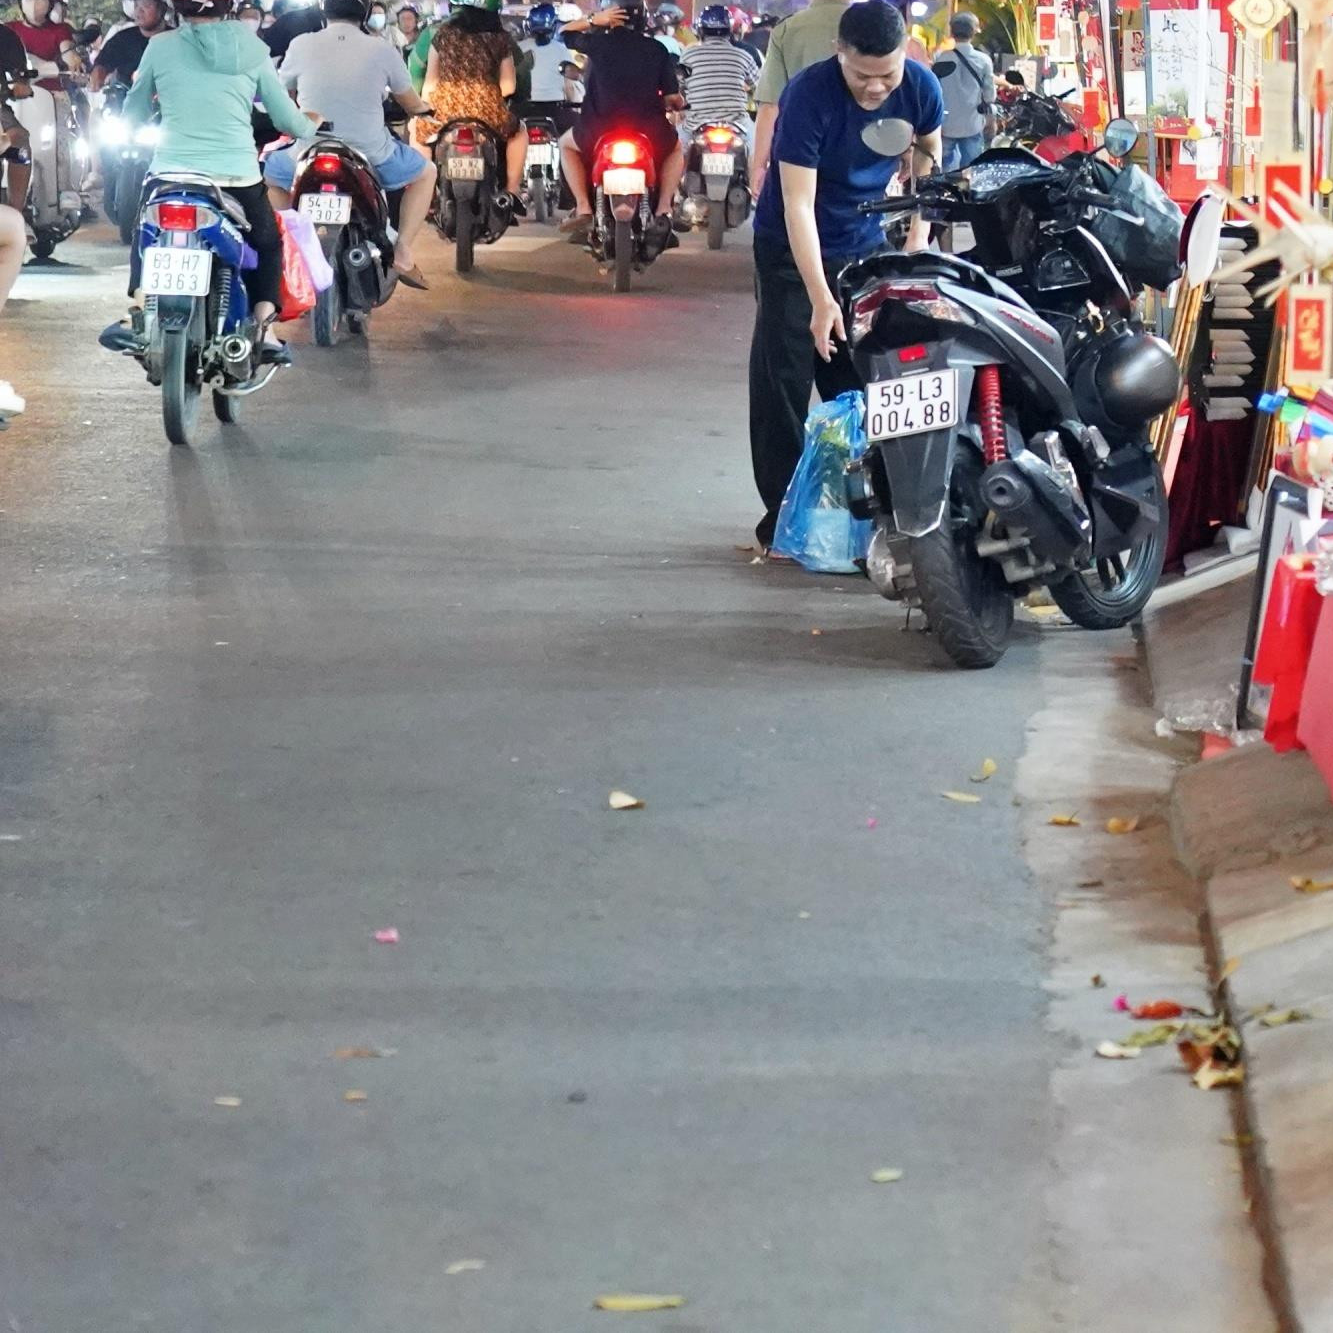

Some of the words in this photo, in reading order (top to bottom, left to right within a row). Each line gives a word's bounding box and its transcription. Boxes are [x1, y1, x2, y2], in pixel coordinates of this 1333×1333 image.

[150, 272, 200, 292] 3363
[880, 375, 943, 409] 59-L3
[871, 400, 951, 437] 004.88
